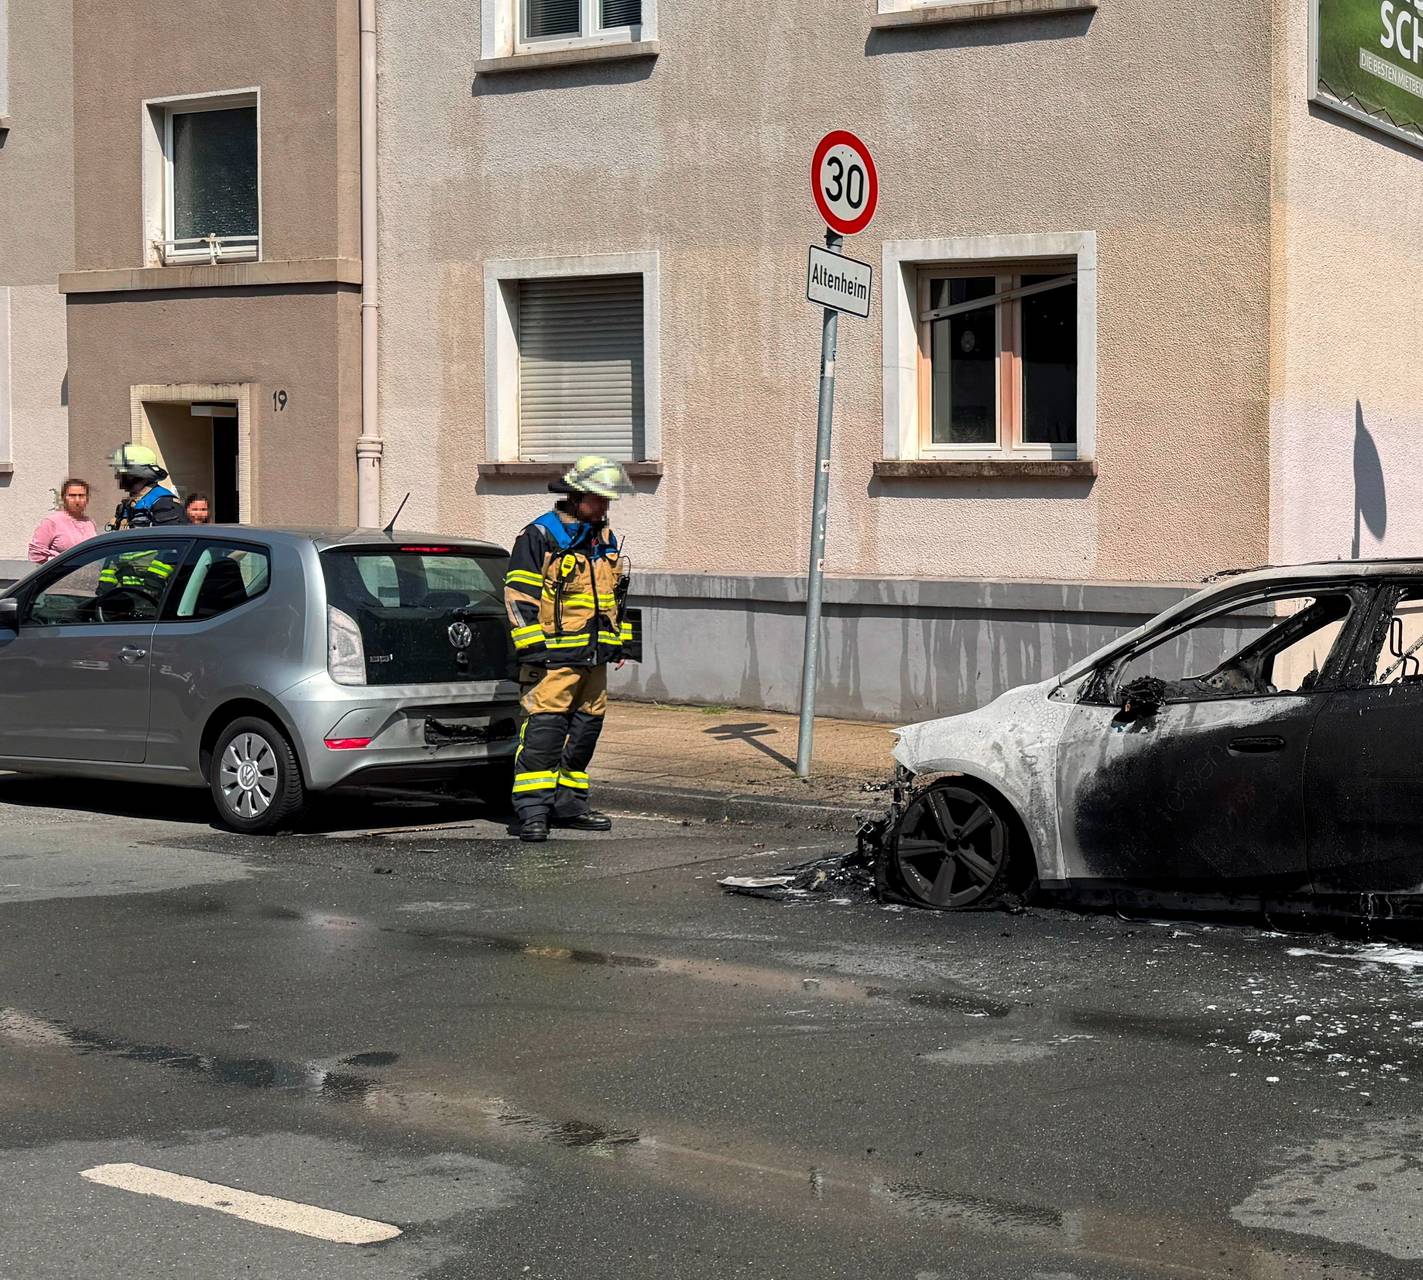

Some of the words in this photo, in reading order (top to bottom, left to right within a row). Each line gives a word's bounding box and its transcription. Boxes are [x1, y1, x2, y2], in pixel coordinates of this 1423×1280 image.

[1361, 53, 1372, 70] DIE
[1373, 60, 1397, 82] BESTEN
[825, 156, 864, 209] 30
[811, 263, 867, 301] Altenheim
[272, 389, 288, 412] 19
